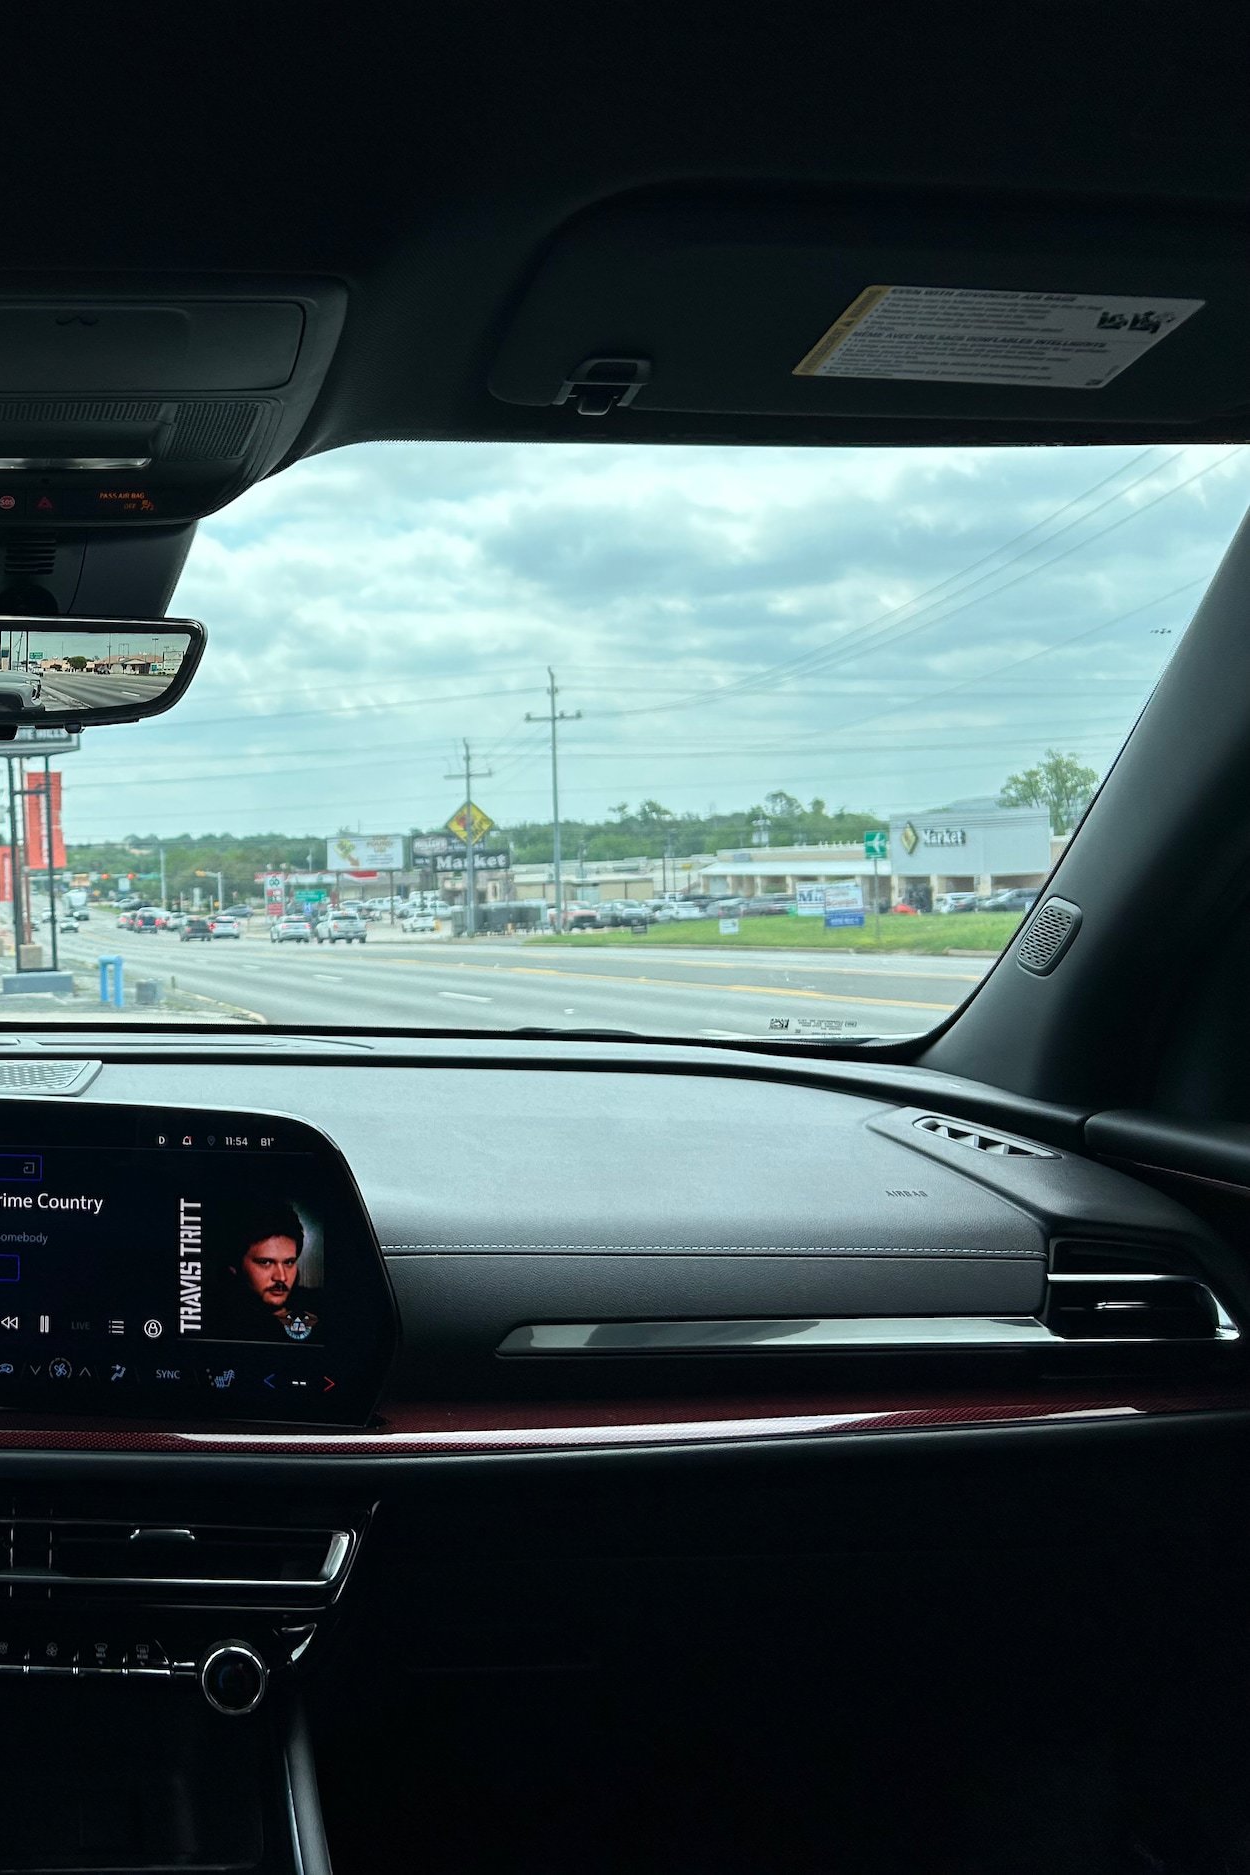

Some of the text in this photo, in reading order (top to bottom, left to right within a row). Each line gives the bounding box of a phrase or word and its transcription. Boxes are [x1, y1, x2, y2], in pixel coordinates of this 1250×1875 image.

[158, 1136, 166, 1145] D
[225, 1136, 248, 1146] 11:54
[885, 1190, 929, 1199] AIRBAG
[37, 1193, 104, 1215] Country
[179, 1197, 202, 1257] TRITT
[179, 1259, 202, 1335] TRAVIS
[70, 1320, 91, 1331] LIVE
[155, 1369, 181, 1380] SYNC
